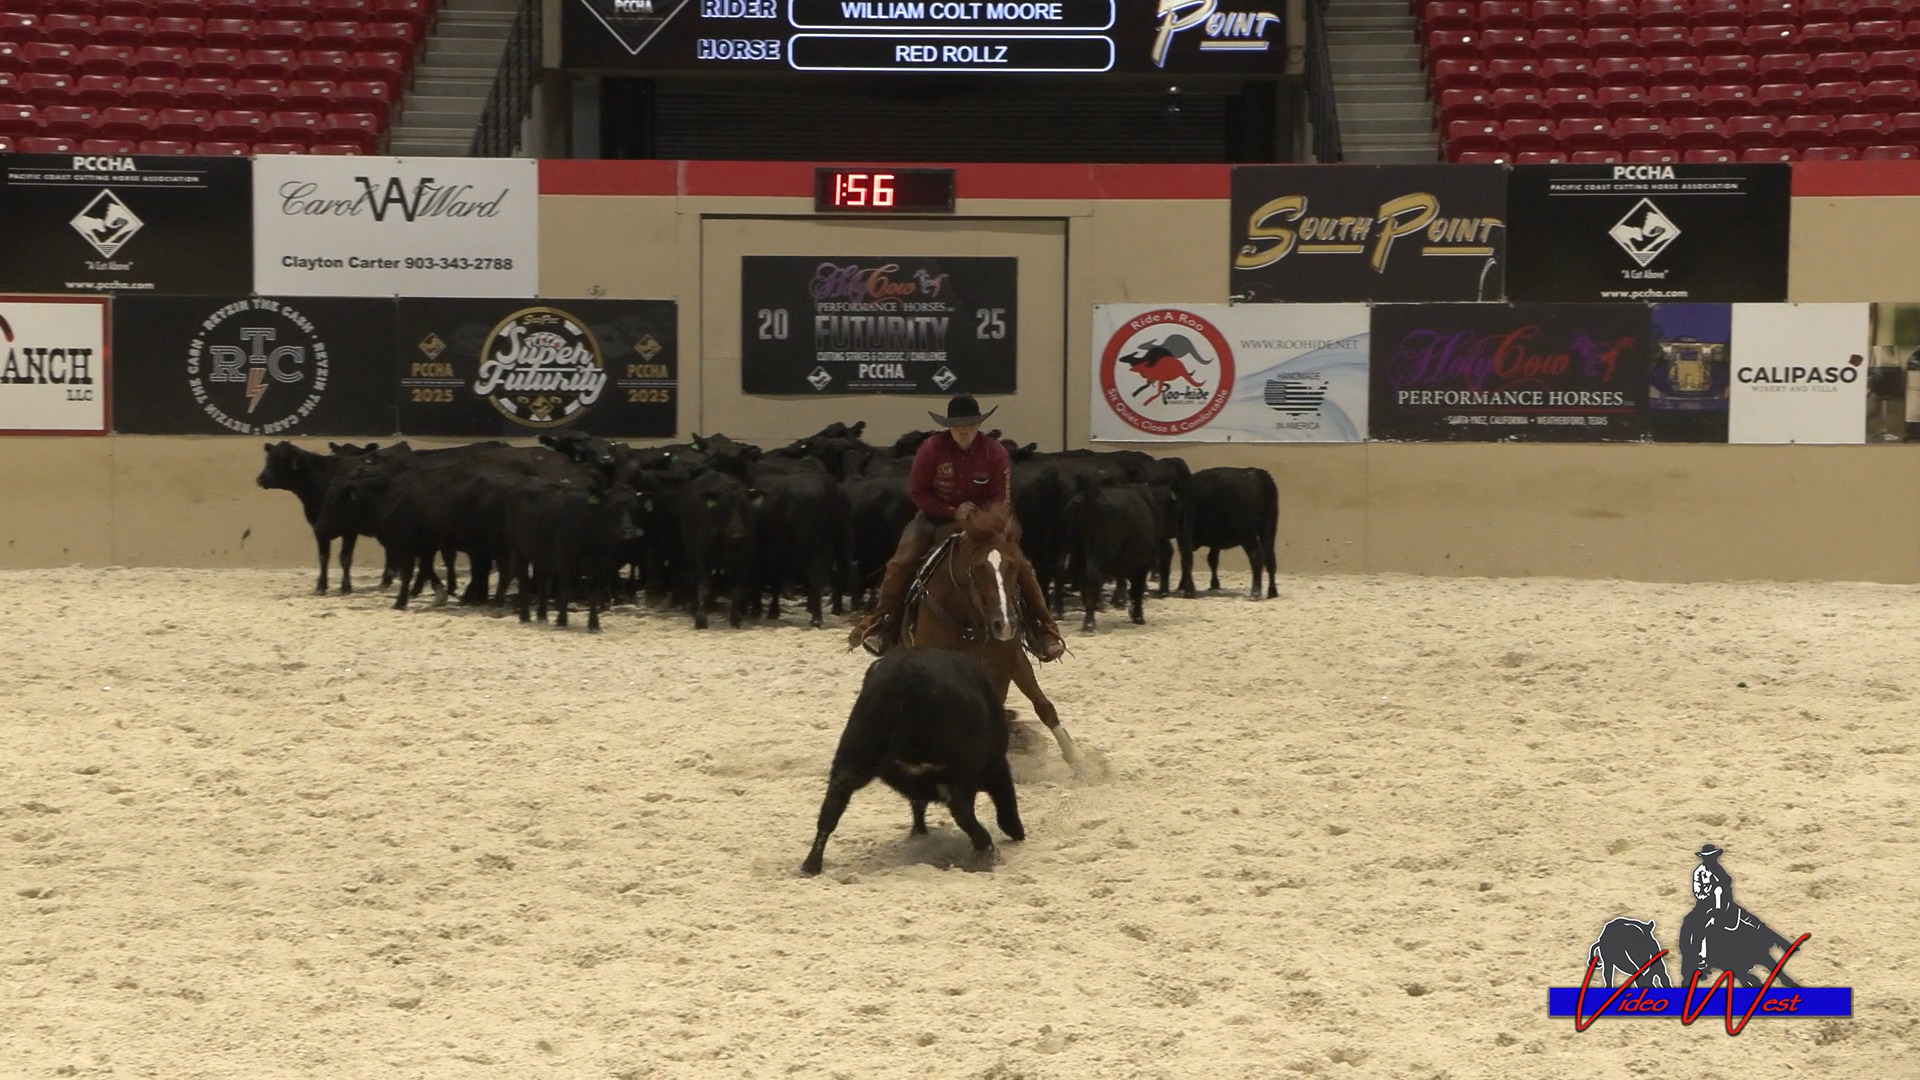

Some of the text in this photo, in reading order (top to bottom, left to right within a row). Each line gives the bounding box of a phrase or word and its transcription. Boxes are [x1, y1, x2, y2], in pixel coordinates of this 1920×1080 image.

[700, 0, 777, 18] RIDER
[841, 2, 1063, 20] WILLIAM COLT MOORE
[697, 39, 781, 60] HORSE
[895, 45, 1008, 63] RED ROLLZ
[73, 156, 137, 171] PCCHA
[1612, 165, 1675, 180] PCCHA
[835, 173, 895, 207] 1:56
[1681, 182, 1739, 190] ASSOCIATION
[278, 180, 510, 218] Carol Ward
[281, 255, 513, 271] Clayton Carter 903-343-2788
[64, 280, 155, 291] www.pccha.com
[1600, 288, 1689, 299] www.pccha.com
[817, 302, 897, 312] PERFORMANCE
[903, 302, 946, 312] HORSES
[251, 299, 281, 313] THE
[281, 306, 315, 334] CASH
[758, 308, 789, 340] 20
[976, 308, 1006, 340] 25
[1130, 311, 1204, 331] Ride A Roo
[814, 315, 949, 350] FUTURITY
[496, 326, 595, 365] Super
[1240, 339, 1359, 350] WWW.ROOHIDE.NET
[411, 363, 454, 377] PCCHA
[628, 364, 669, 378] PCCHA
[859, 363, 905, 379] PCCHA
[1737, 366, 1858, 384] CALIPASO
[474, 359, 607, 405] Futurity
[66, 389, 93, 401] LLC
[411, 388, 454, 402] 2025
[628, 389, 669, 403] 2025
[1398, 390, 1543, 406] PERFORMANCE
[1548, 390, 1624, 406] HORSES
[1141, 420, 1168, 433] Close
[1170, 424, 1178, 432] &
[1180, 389, 1228, 431] Comfortable
